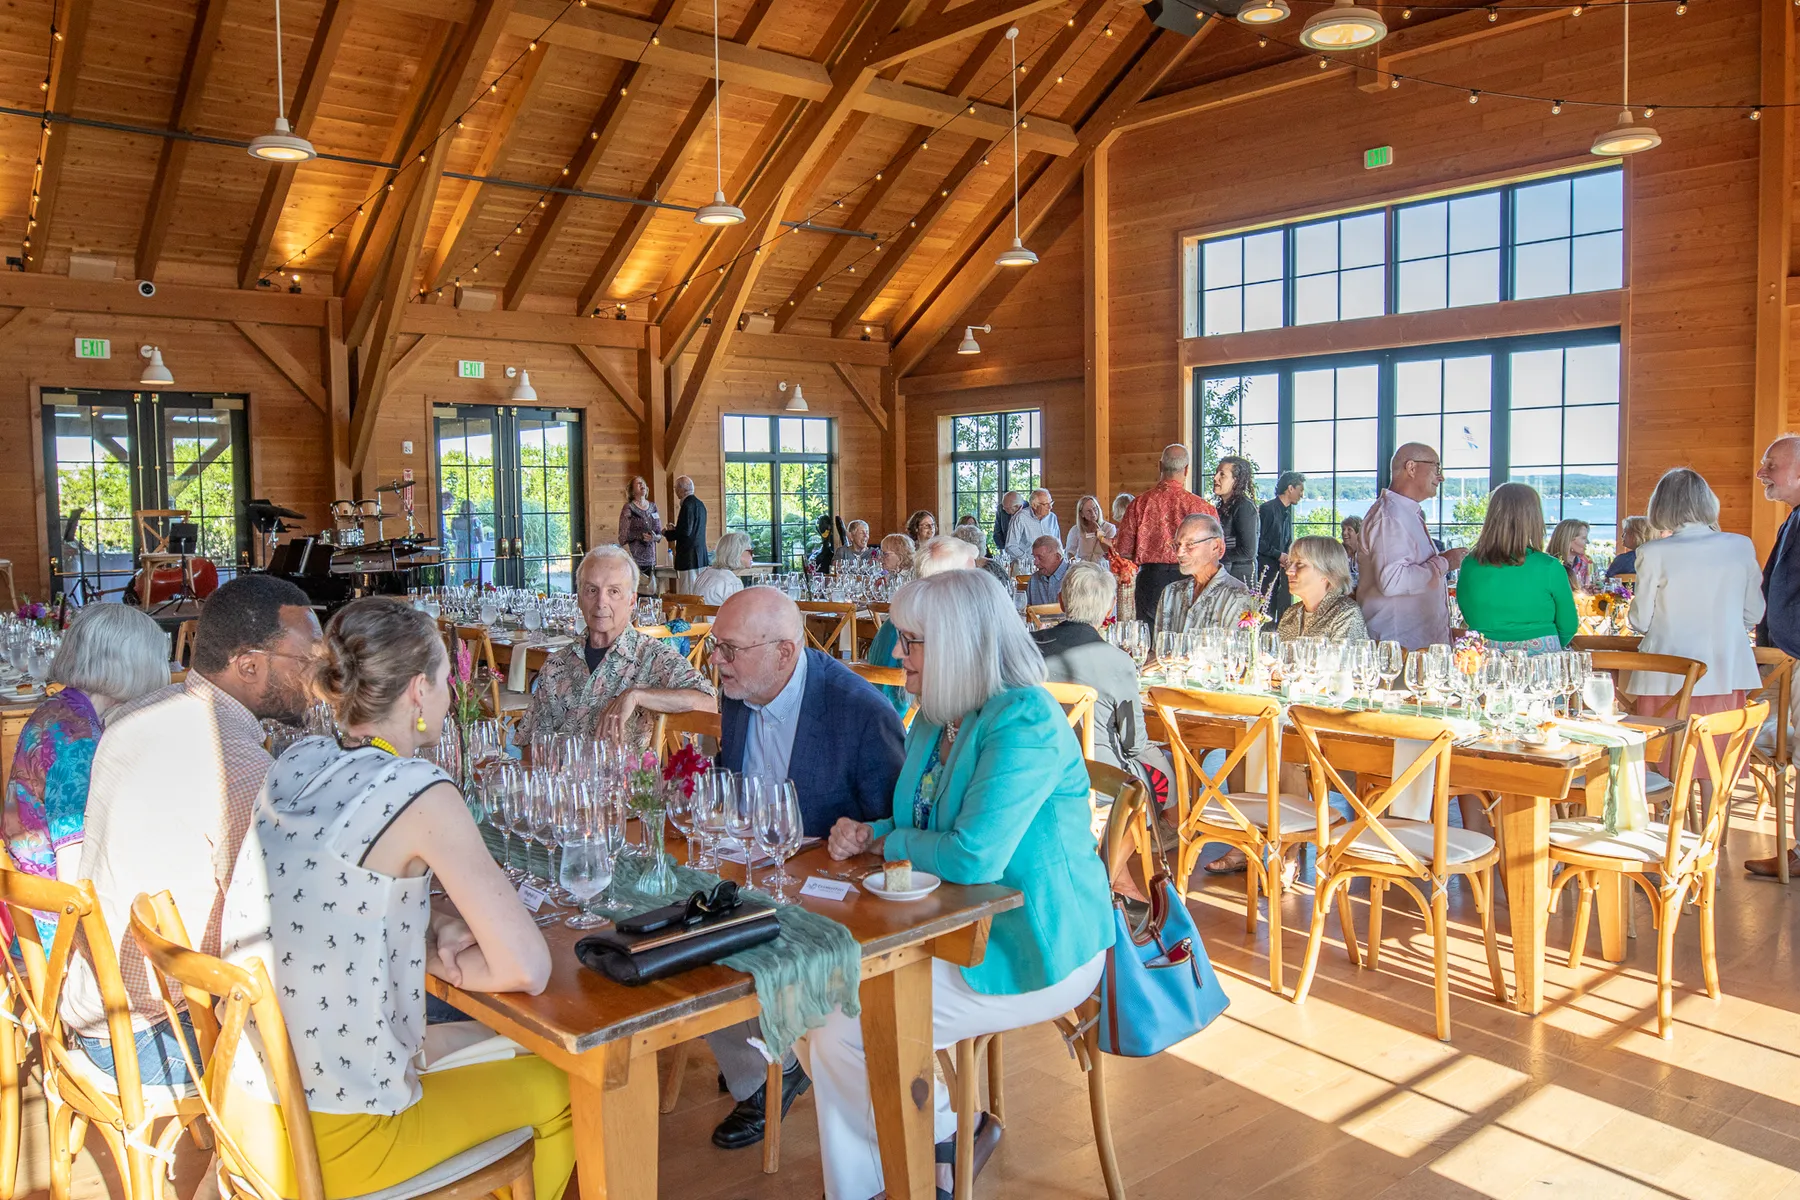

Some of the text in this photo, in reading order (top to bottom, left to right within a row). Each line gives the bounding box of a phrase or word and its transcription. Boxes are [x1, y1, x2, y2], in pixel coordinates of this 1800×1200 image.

[1368, 146, 1387, 166] EXIT
[81, 339, 105, 357] EXIT
[464, 361, 481, 377] EXIT
